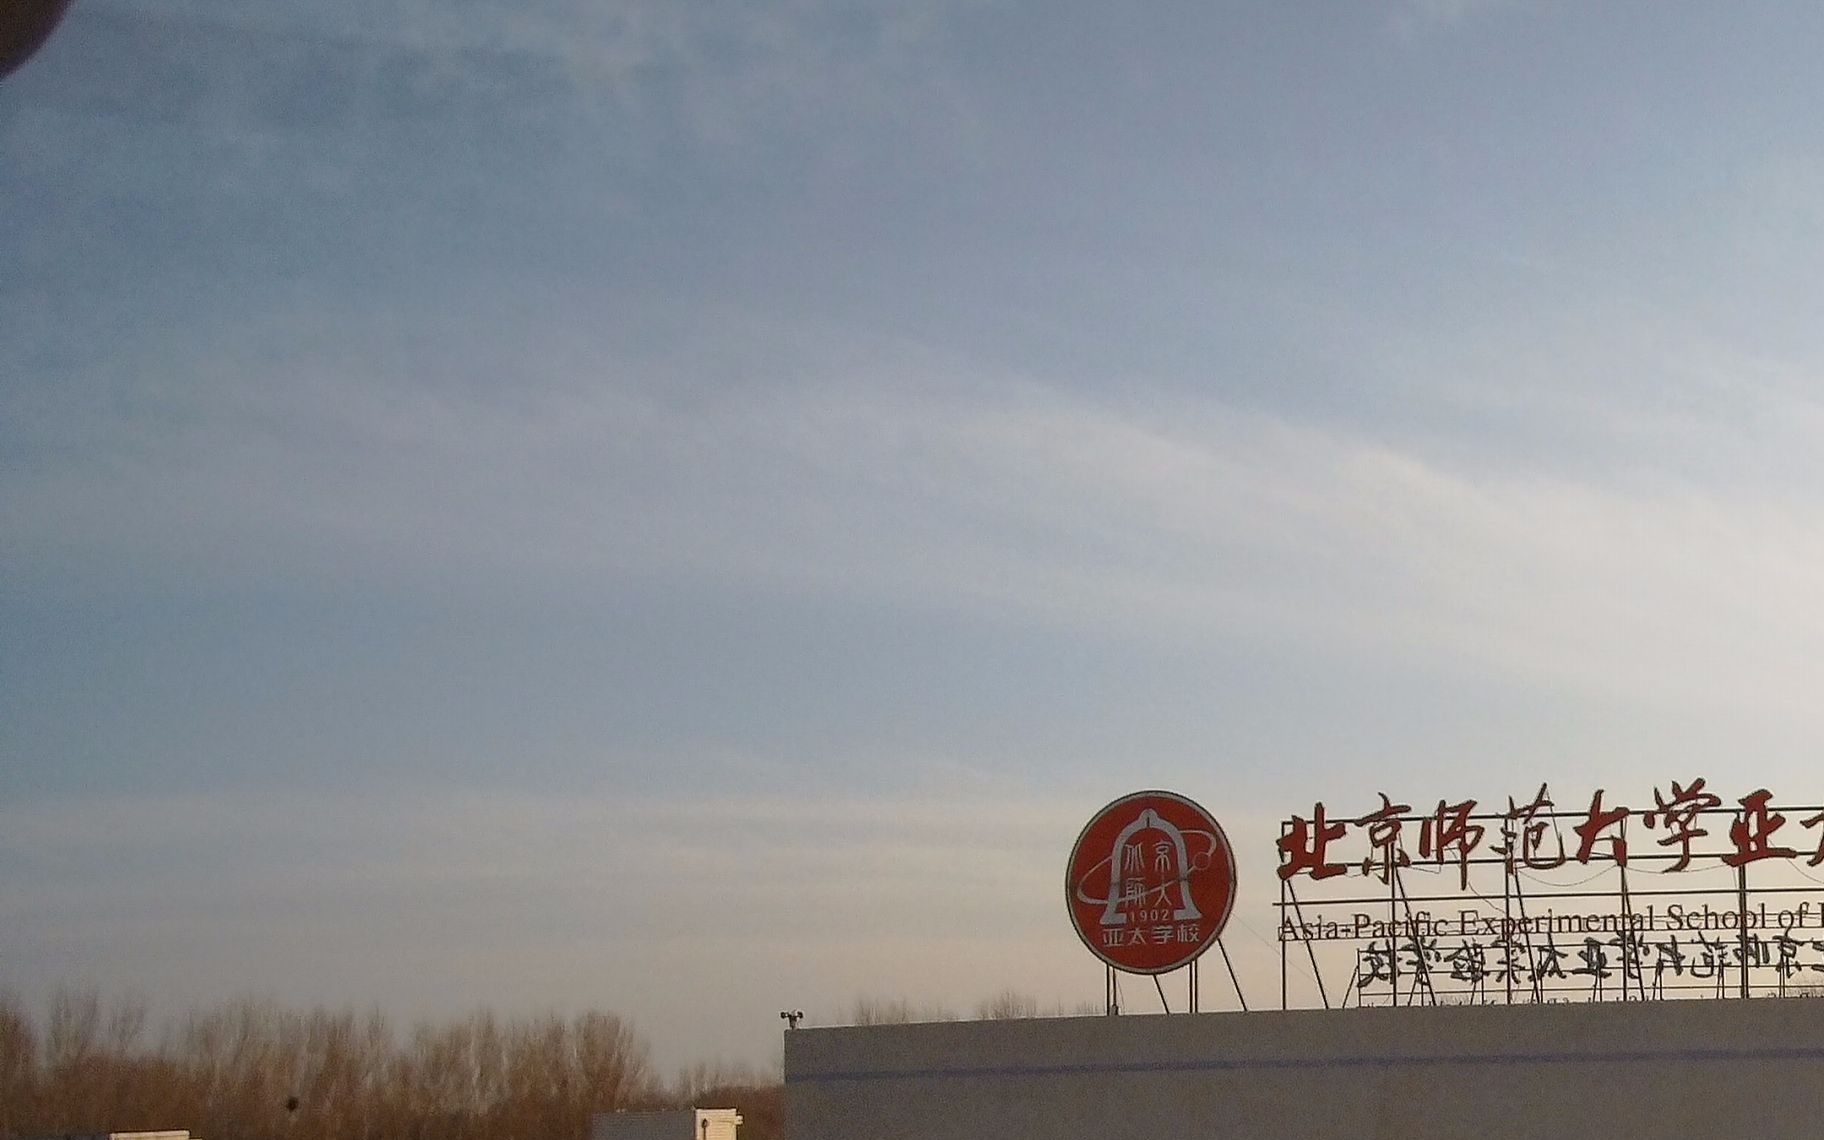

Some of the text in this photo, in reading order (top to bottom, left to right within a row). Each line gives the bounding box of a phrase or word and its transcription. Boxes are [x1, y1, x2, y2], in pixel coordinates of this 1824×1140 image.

[1129, 909, 1170, 922] 1902
[1279, 910, 1449, 941] Asia-Pacific
[1459, 902, 1653, 942] Experimental
[1666, 902, 1766, 931] School
[1777, 901, 1810, 930] of
[1102, 923, 1200, 947] 亚太学校
